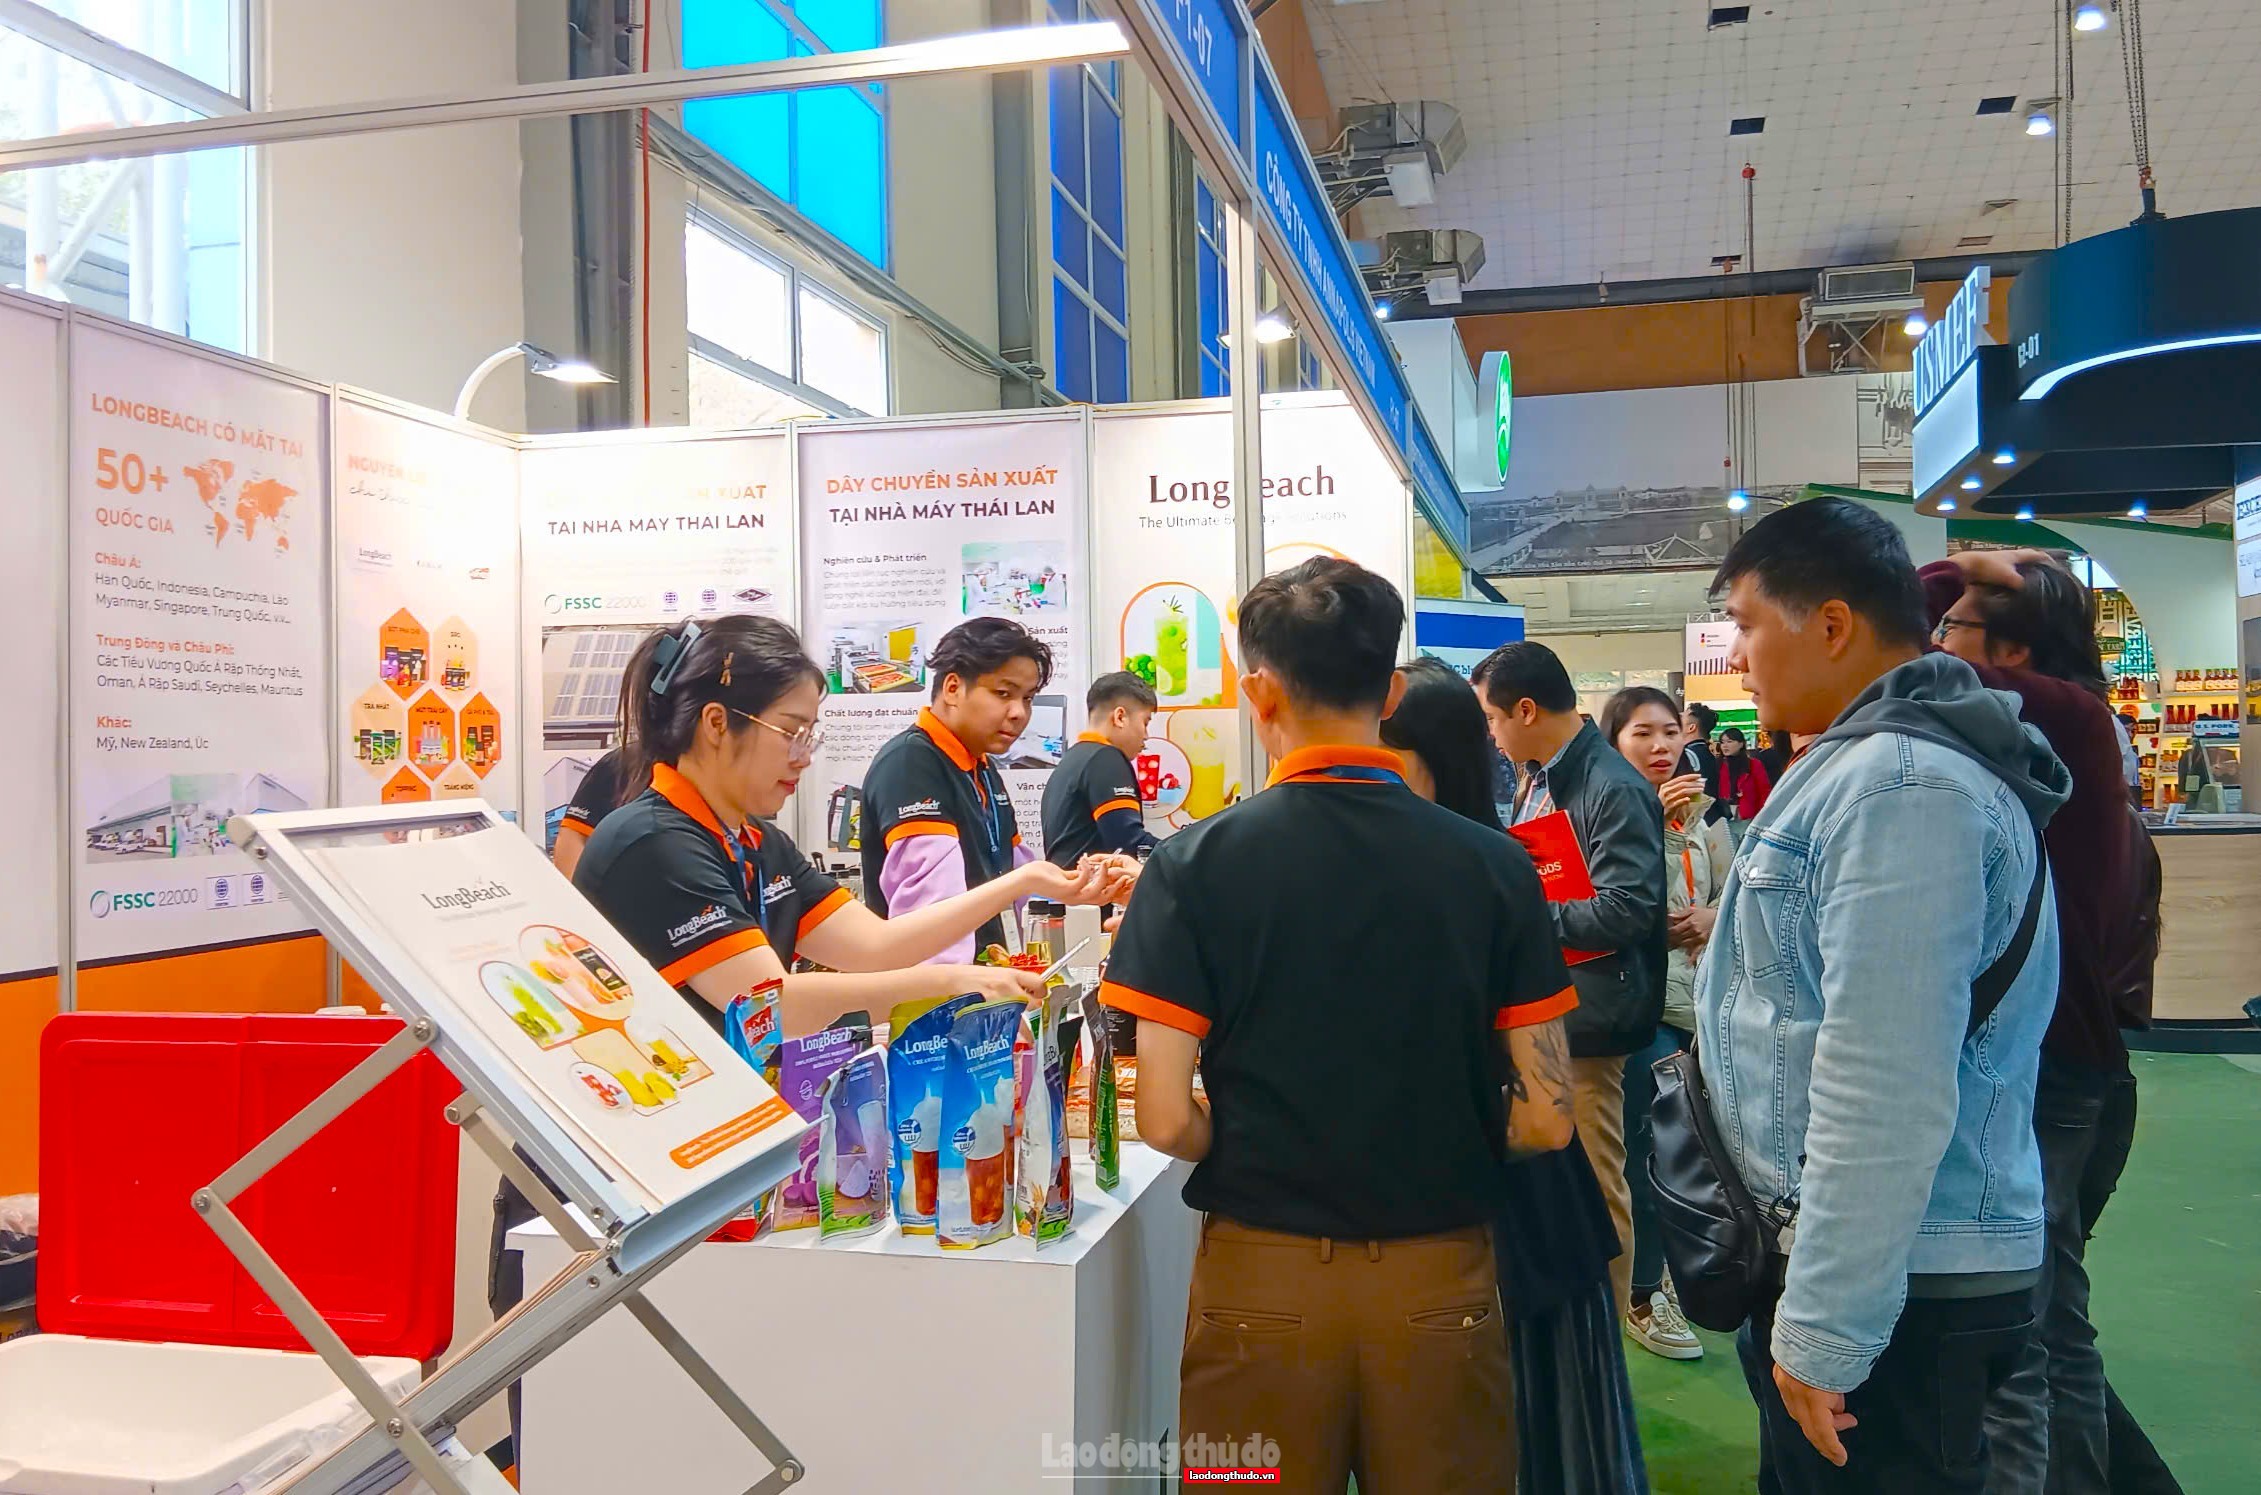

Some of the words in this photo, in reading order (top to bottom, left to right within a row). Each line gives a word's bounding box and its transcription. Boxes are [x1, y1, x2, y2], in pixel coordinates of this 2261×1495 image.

[1912, 266, 1982, 417] USMEF
[91, 392, 208, 437] LONGBEACH
[95, 447, 169, 494] 50+
[826, 474, 865, 494] DÂY
[870, 469, 950, 492] CHUYỀN
[956, 467, 997, 488] SẢN
[1003, 464, 1058, 486] XUẤT
[1148, 464, 1335, 509] Longeach
[96, 504, 143, 529] QUỐC
[148, 516, 174, 534] GIA
[726, 514, 765, 529] LAN
[829, 507, 858, 527] TẠI
[865, 501, 906, 522] NHÀ
[912, 498, 955, 519] MÁY
[961, 497, 1008, 518] THÁI
[1014, 499, 1055, 516] LAN
[1138, 516, 1163, 529] The
[874, 555, 881, 563] &
[211, 605, 241, 622] Trung
[564, 597, 602, 610] FSSC
[96, 633, 132, 651] Trung
[183, 660, 212, 674] Quốc
[97, 674, 135, 689] Oman,
[96, 715, 132, 729] Khác:
[96, 735, 118, 752] Mỹ,
[120, 736, 147, 749] New
[148, 736, 193, 751] Zealand,
[195, 735, 209, 749] Úc
[898, 799, 940, 816] LongBeach
[112, 892, 156, 911] FSSC
[157, 888, 198, 907] 22000
[420, 880, 512, 909] LongBeach
[666, 905, 728, 941] LongBeach
[799, 1029, 852, 1053] LongBeach
[904, 1034, 949, 1054] LongBe
[963, 1034, 1010, 1061] LongBeach
